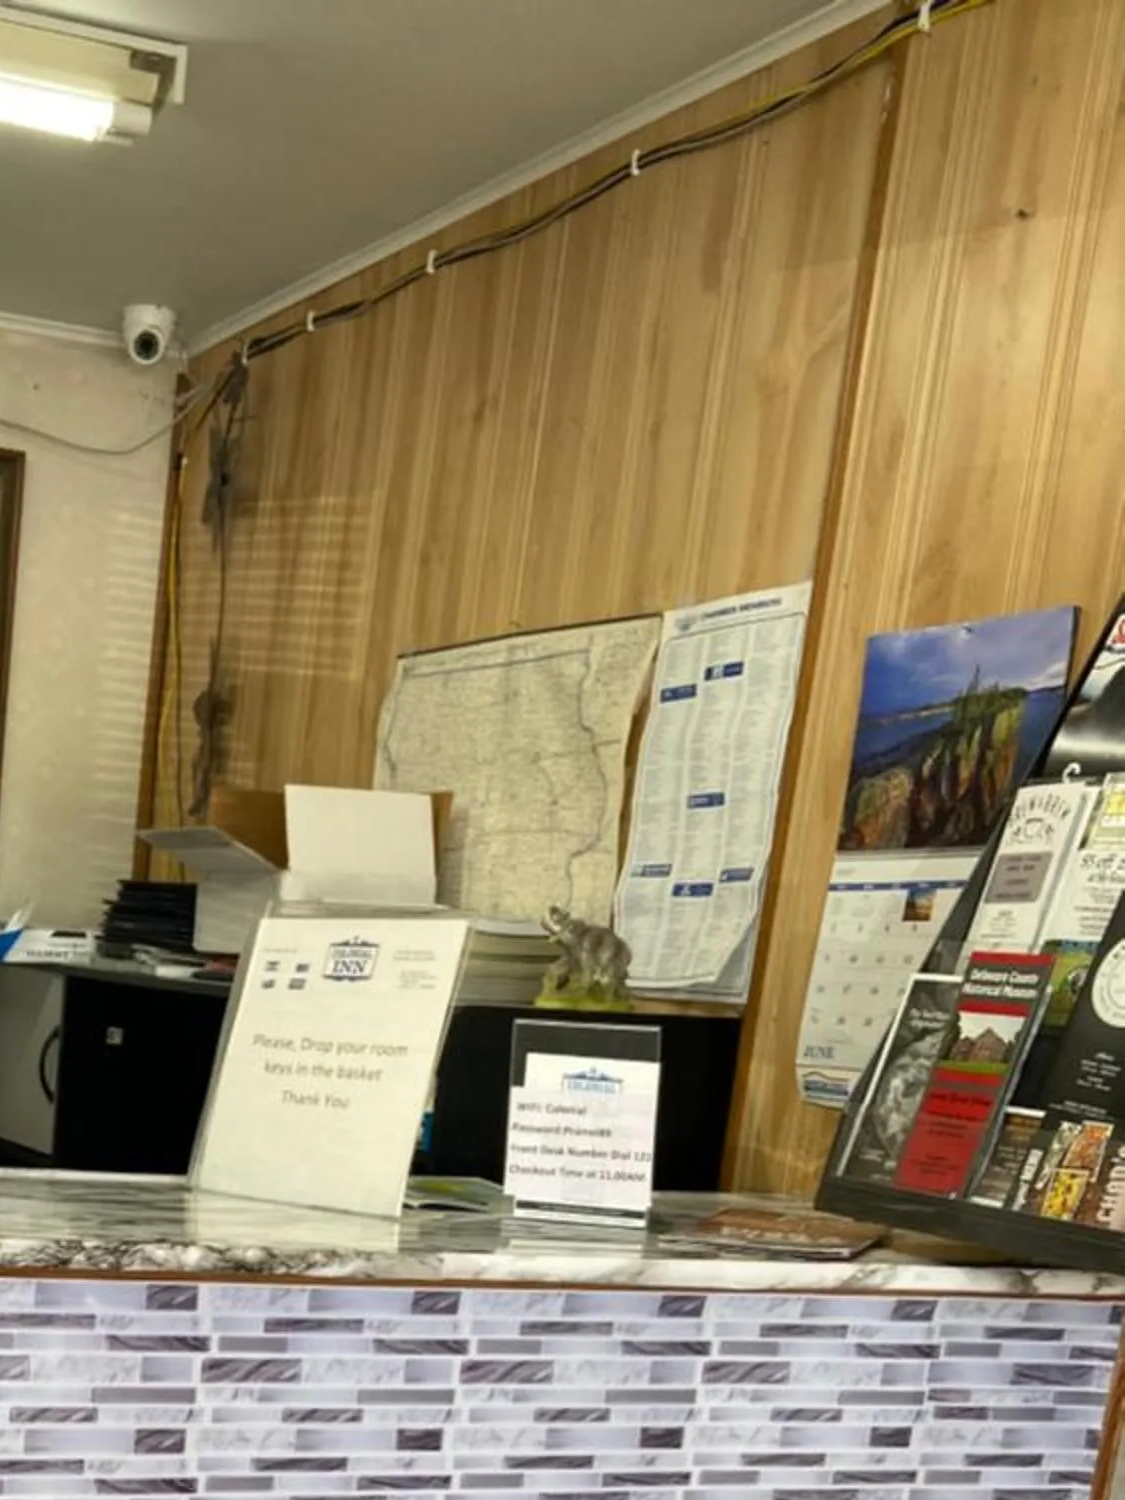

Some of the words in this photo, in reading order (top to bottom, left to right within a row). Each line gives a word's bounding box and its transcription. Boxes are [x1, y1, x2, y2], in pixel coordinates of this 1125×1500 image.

[332, 960, 368, 973] INN
[300, 1037, 334, 1053] Drop
[336, 1042, 368, 1056] your
[369, 1044, 409, 1056] room
[264, 1060, 293, 1076] keys
[295, 1061, 309, 1074] in
[312, 1063, 334, 1077] the
[336, 1065, 384, 1081] basket
[282, 1090, 319, 1105] Thank
[325, 1094, 351, 1109] You
